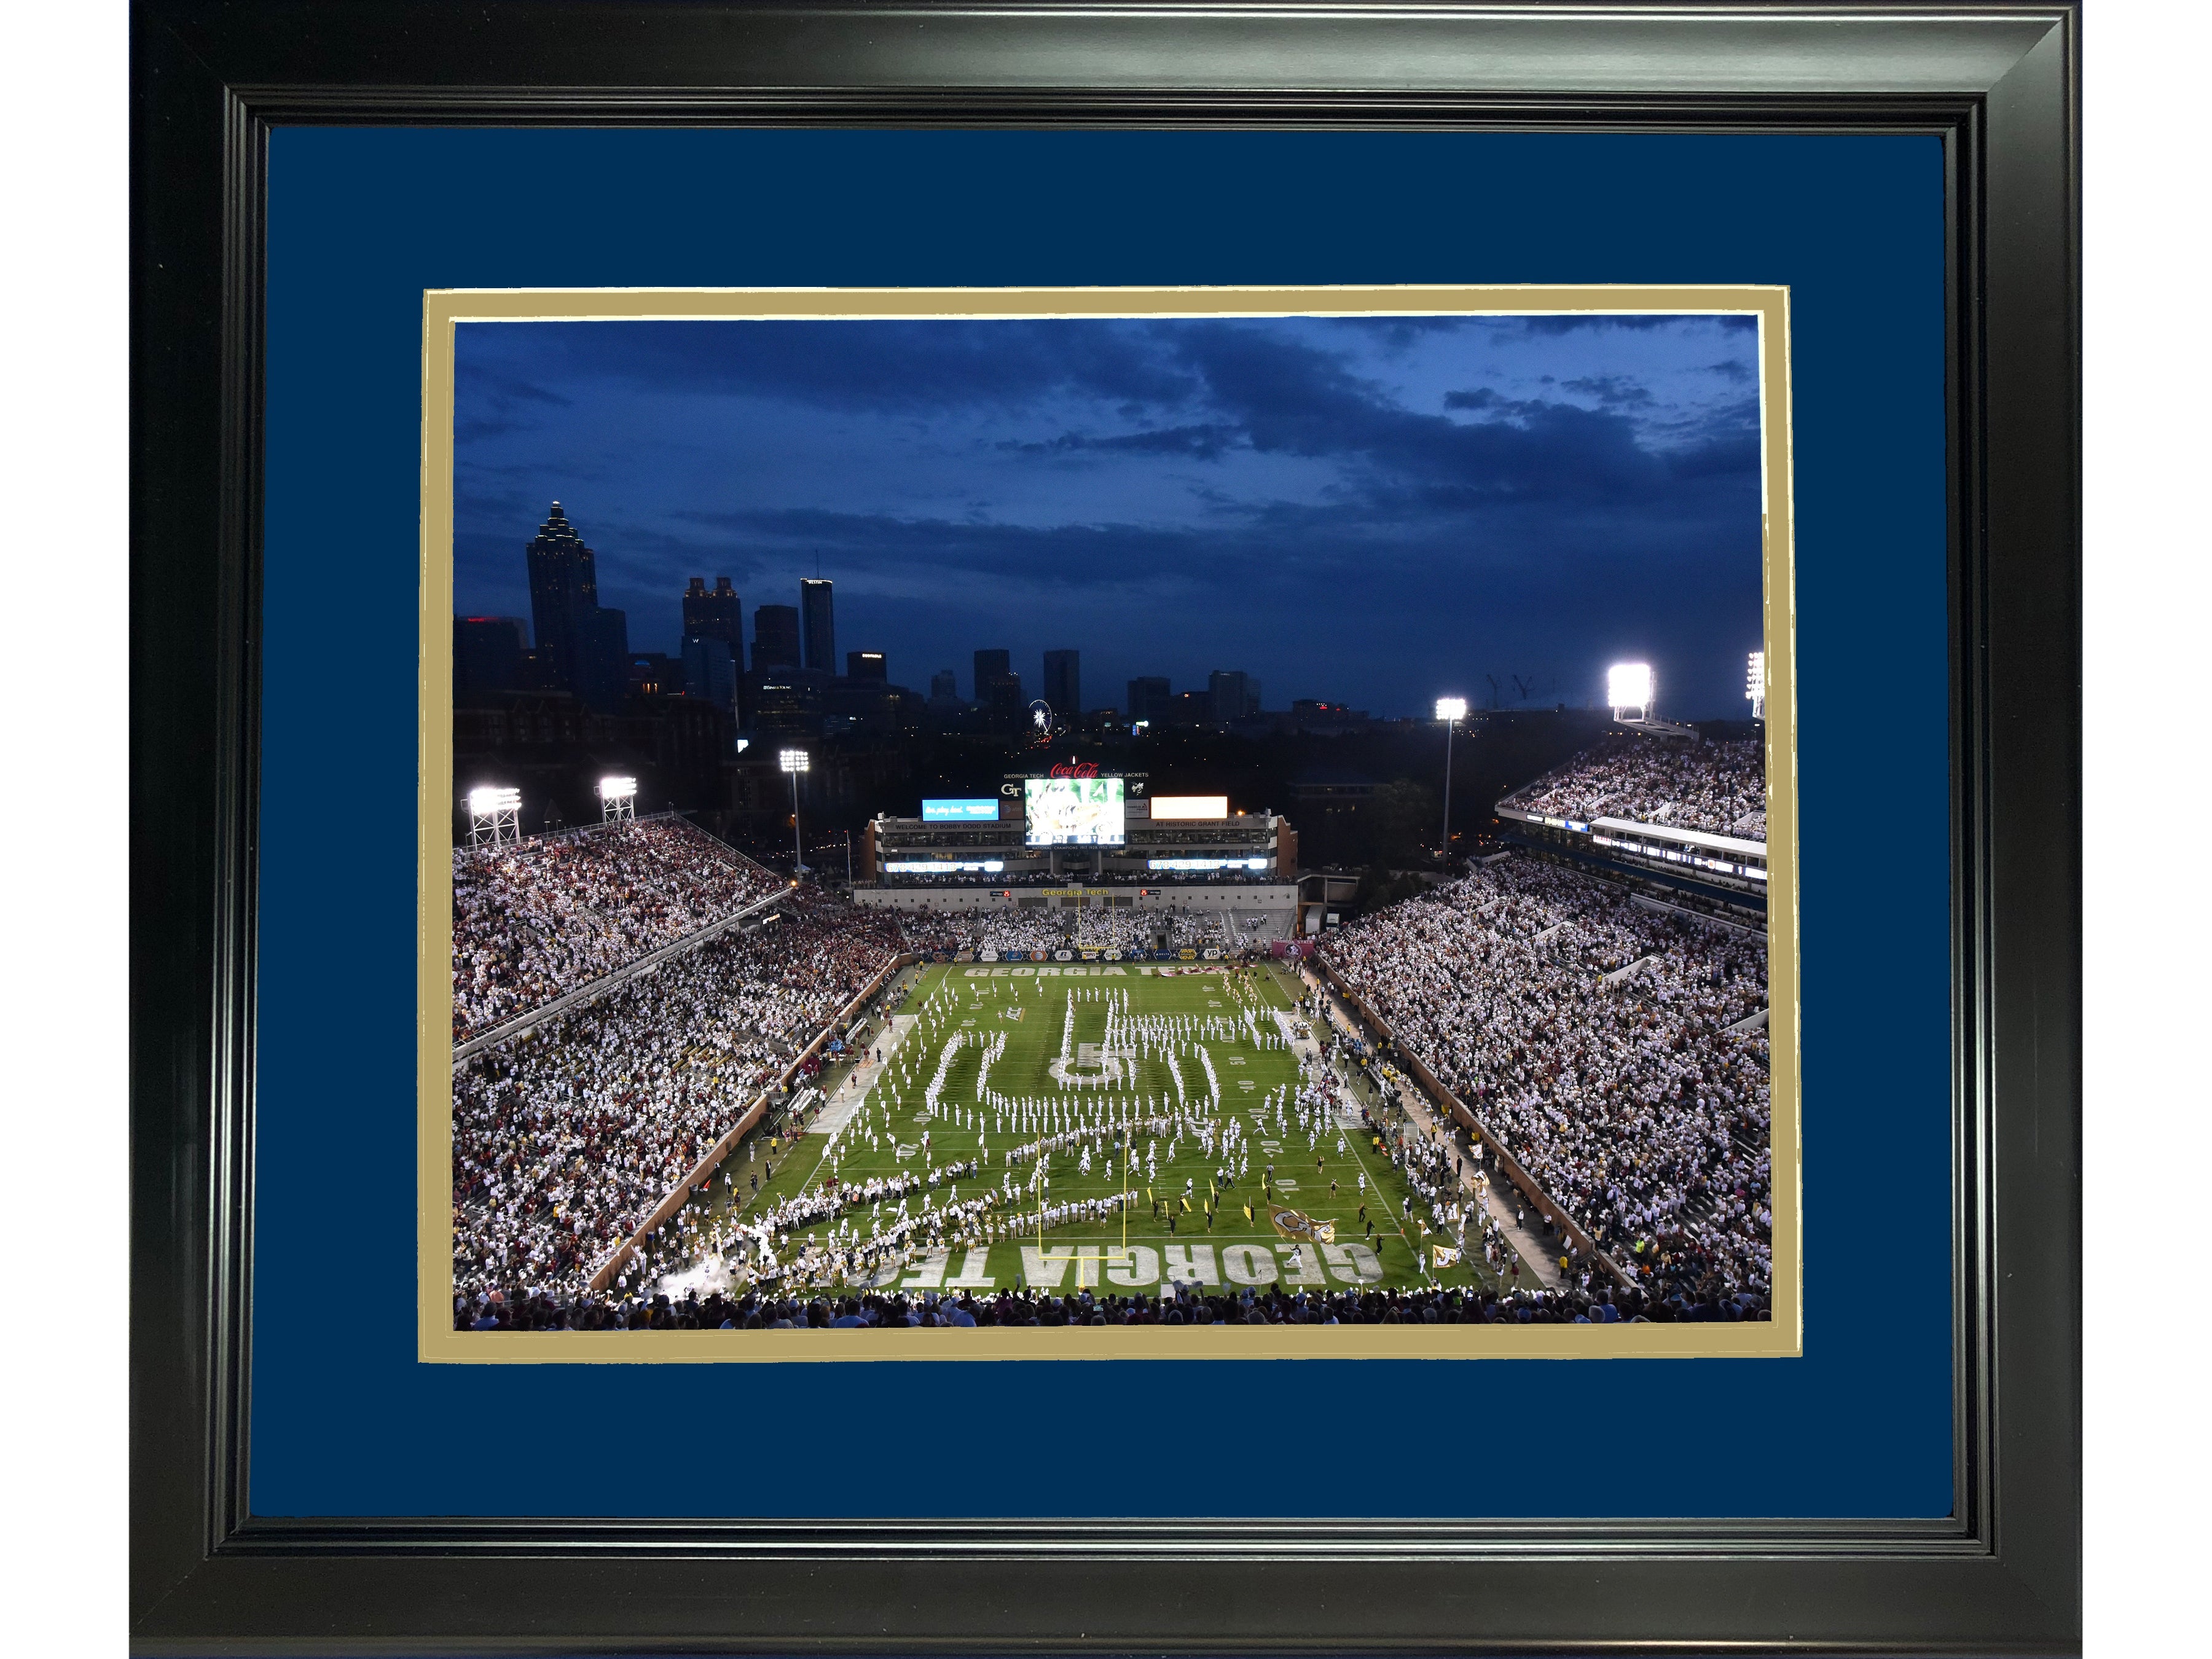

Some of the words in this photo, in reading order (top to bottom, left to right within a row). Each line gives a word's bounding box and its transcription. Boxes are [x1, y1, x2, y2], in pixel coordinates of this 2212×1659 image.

[964, 967, 1128, 976] GEORGIA
[1006, 1006, 1022, 1021] ACC
[1237, 1080, 1257, 1090] 40
[899, 1143, 919, 1156] 20
[1260, 1140, 1284, 1154] 20
[1274, 1179, 1300, 1193] 10
[1021, 1243, 1384, 1287] GEORGIA
